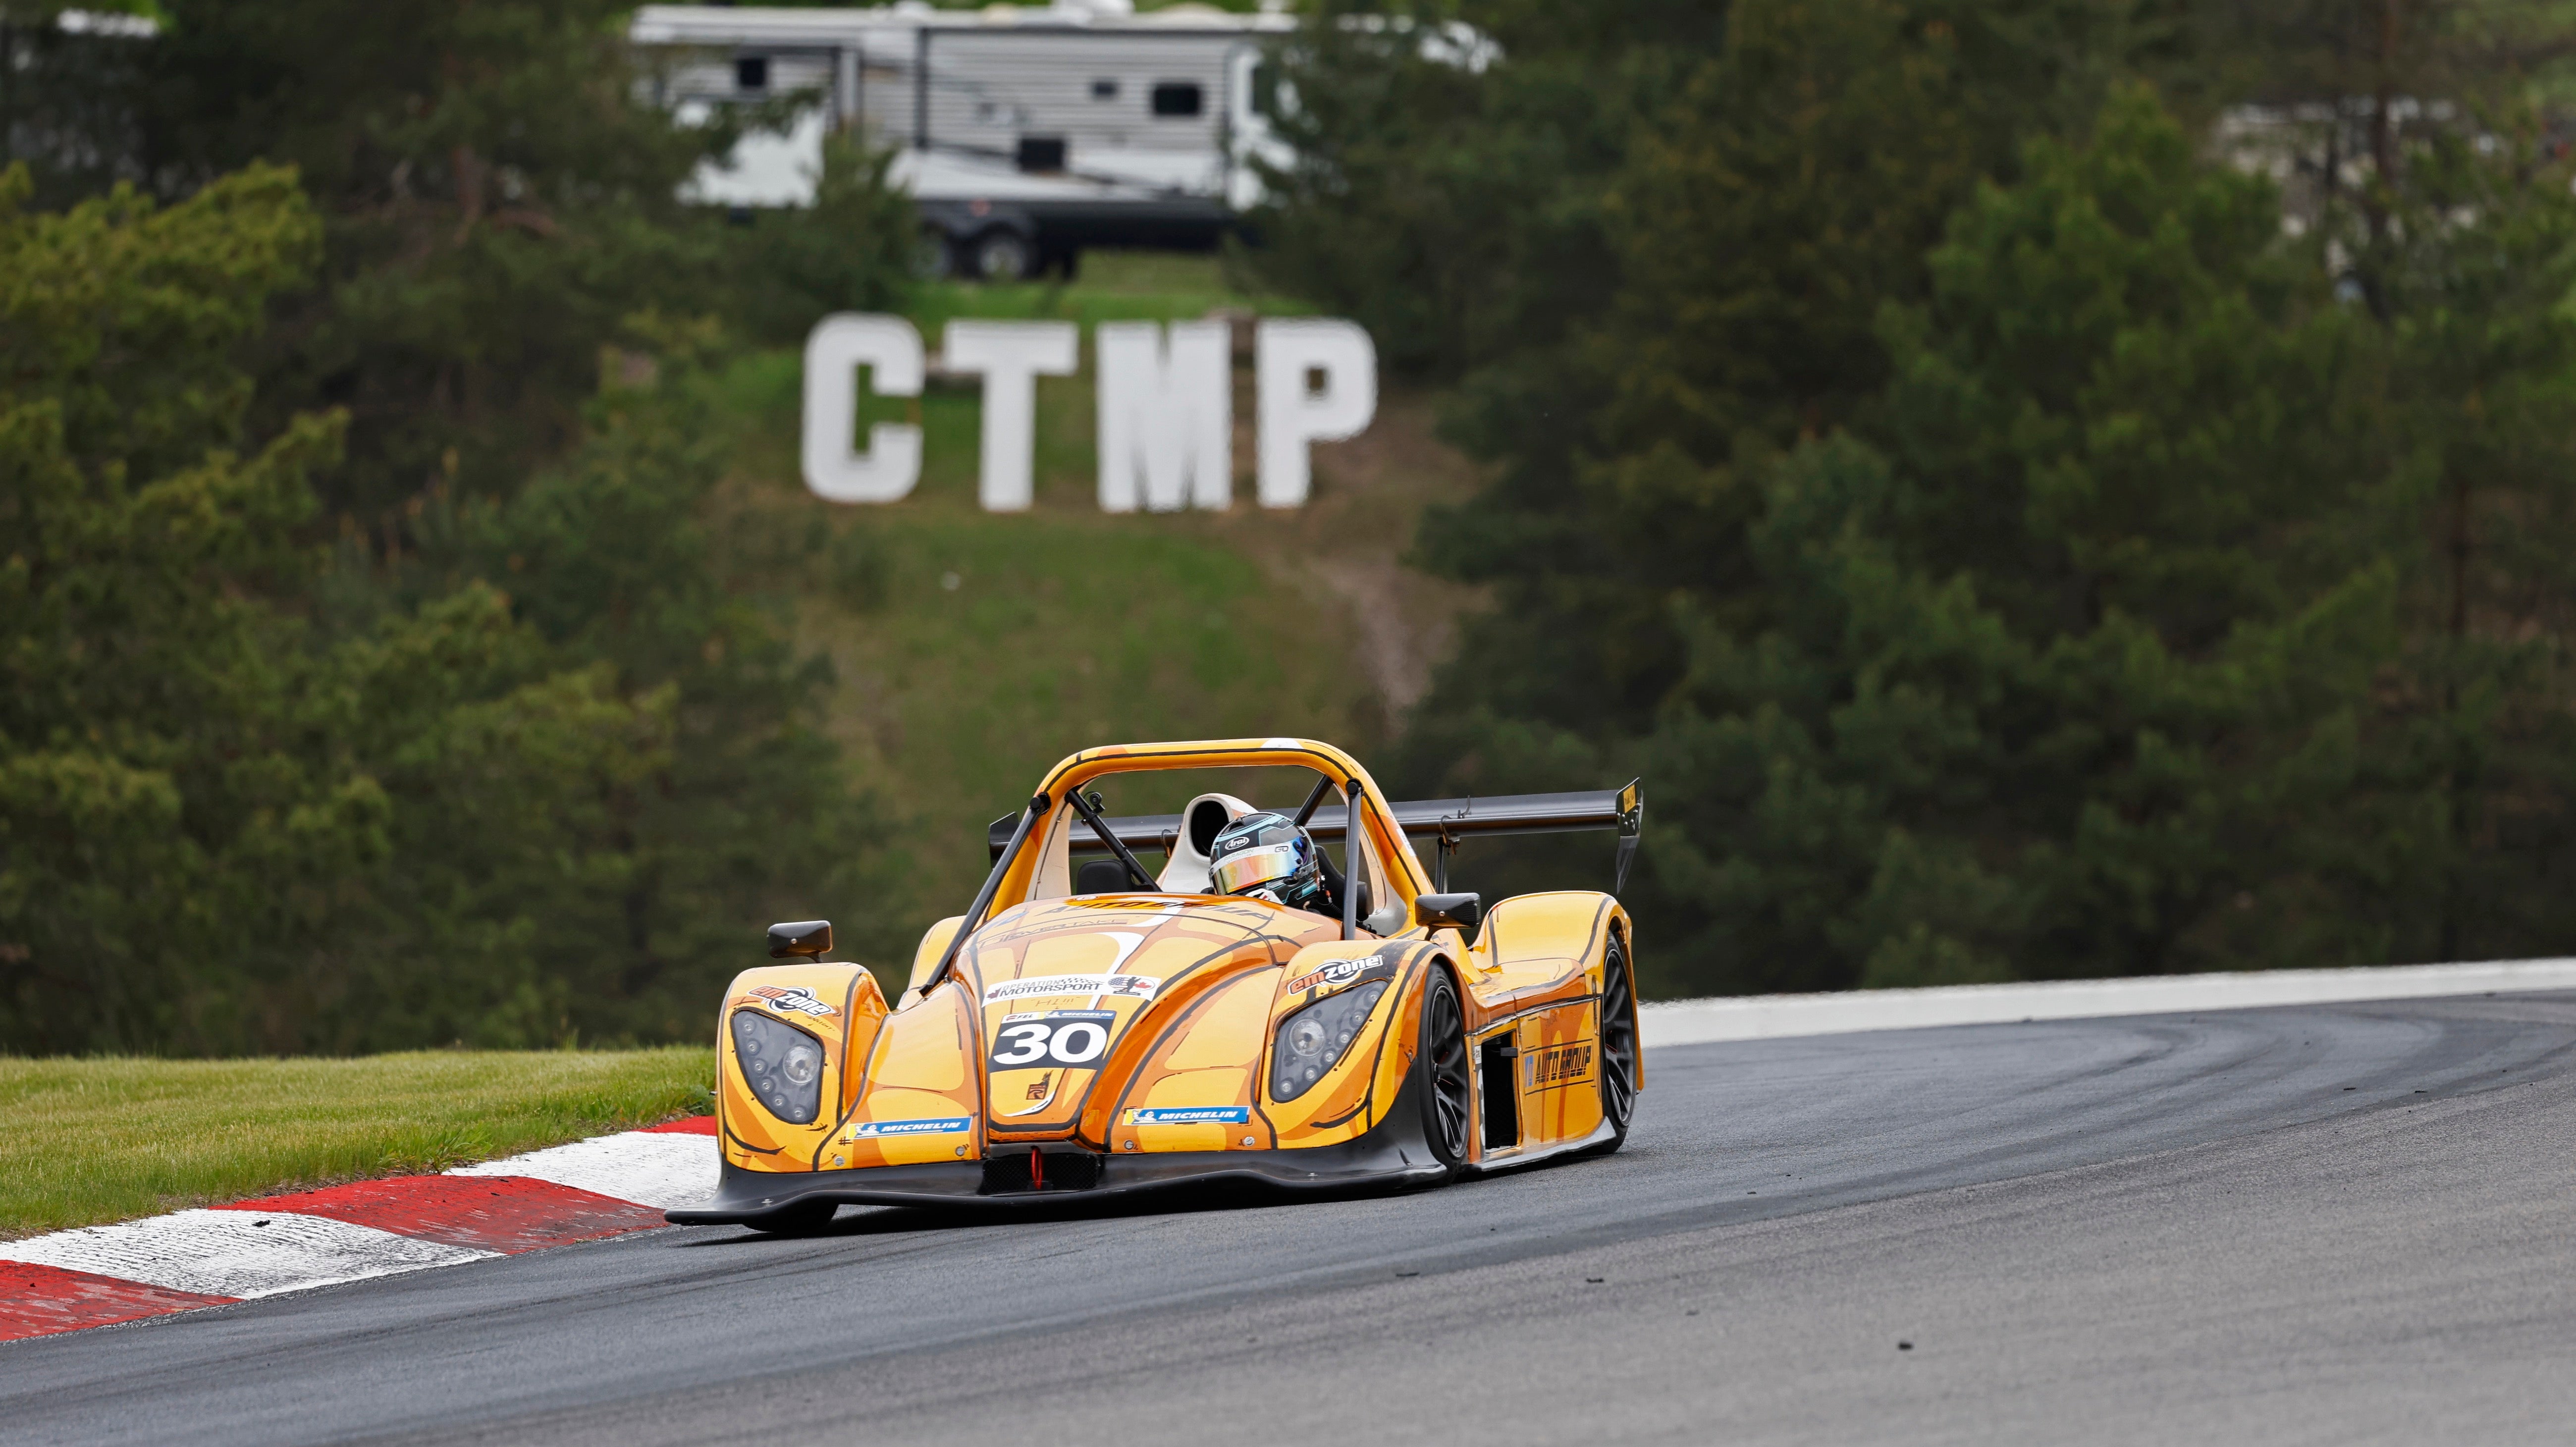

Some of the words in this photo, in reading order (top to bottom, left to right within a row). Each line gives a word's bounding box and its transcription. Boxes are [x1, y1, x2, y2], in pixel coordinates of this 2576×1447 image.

[801, 310, 1378, 513] CTMP
[1228, 838, 1246, 847] Arai
[1003, 980, 1060, 991] OPERATION
[1290, 956, 1380, 994] emzone
[749, 986, 831, 1015] emzone
[1000, 983, 1103, 997] MOTORSPORT
[993, 1022, 1107, 1065] 30
[1535, 1051, 1559, 1085] AUTO
[1558, 1045, 1592, 1079] GROUP
[1158, 1111, 1238, 1120] MICHELIN
[881, 1122, 961, 1132] MICHELIN
